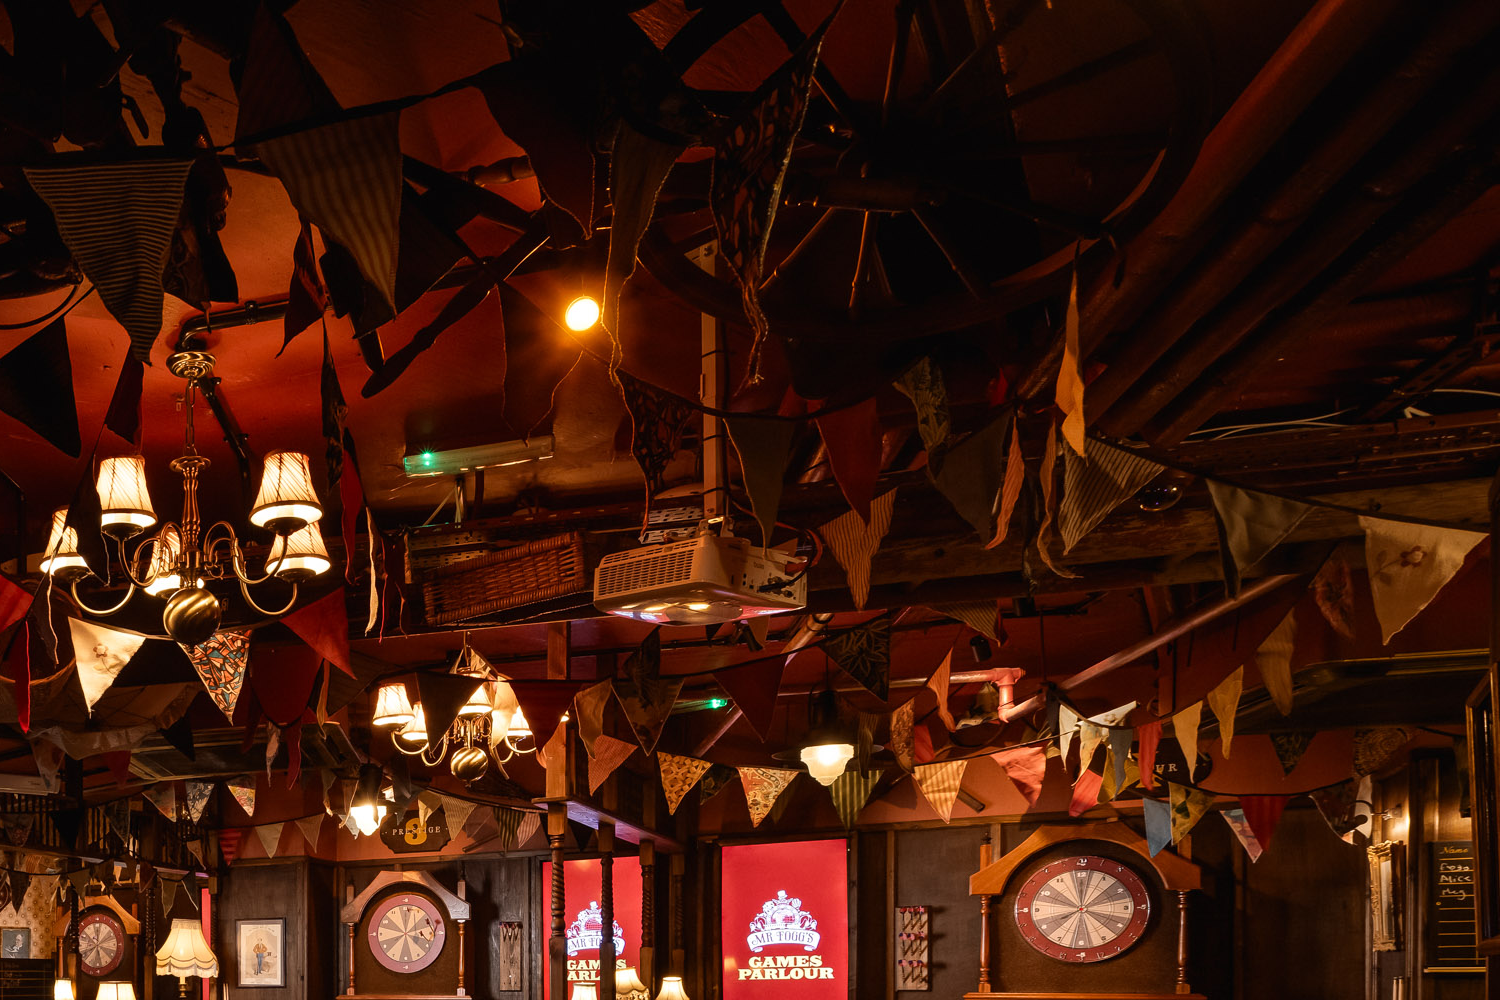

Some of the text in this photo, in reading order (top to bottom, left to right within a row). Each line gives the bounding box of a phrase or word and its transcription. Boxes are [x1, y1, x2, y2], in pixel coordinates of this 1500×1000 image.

[392, 826, 441, 836] PRESTIGE
[569, 938, 587, 950] MR
[752, 932, 814, 946] MR FOGG'S
[567, 959, 627, 970] GAMS
[748, 955, 822, 968] GAMES
[738, 967, 834, 980] PARLOUR
